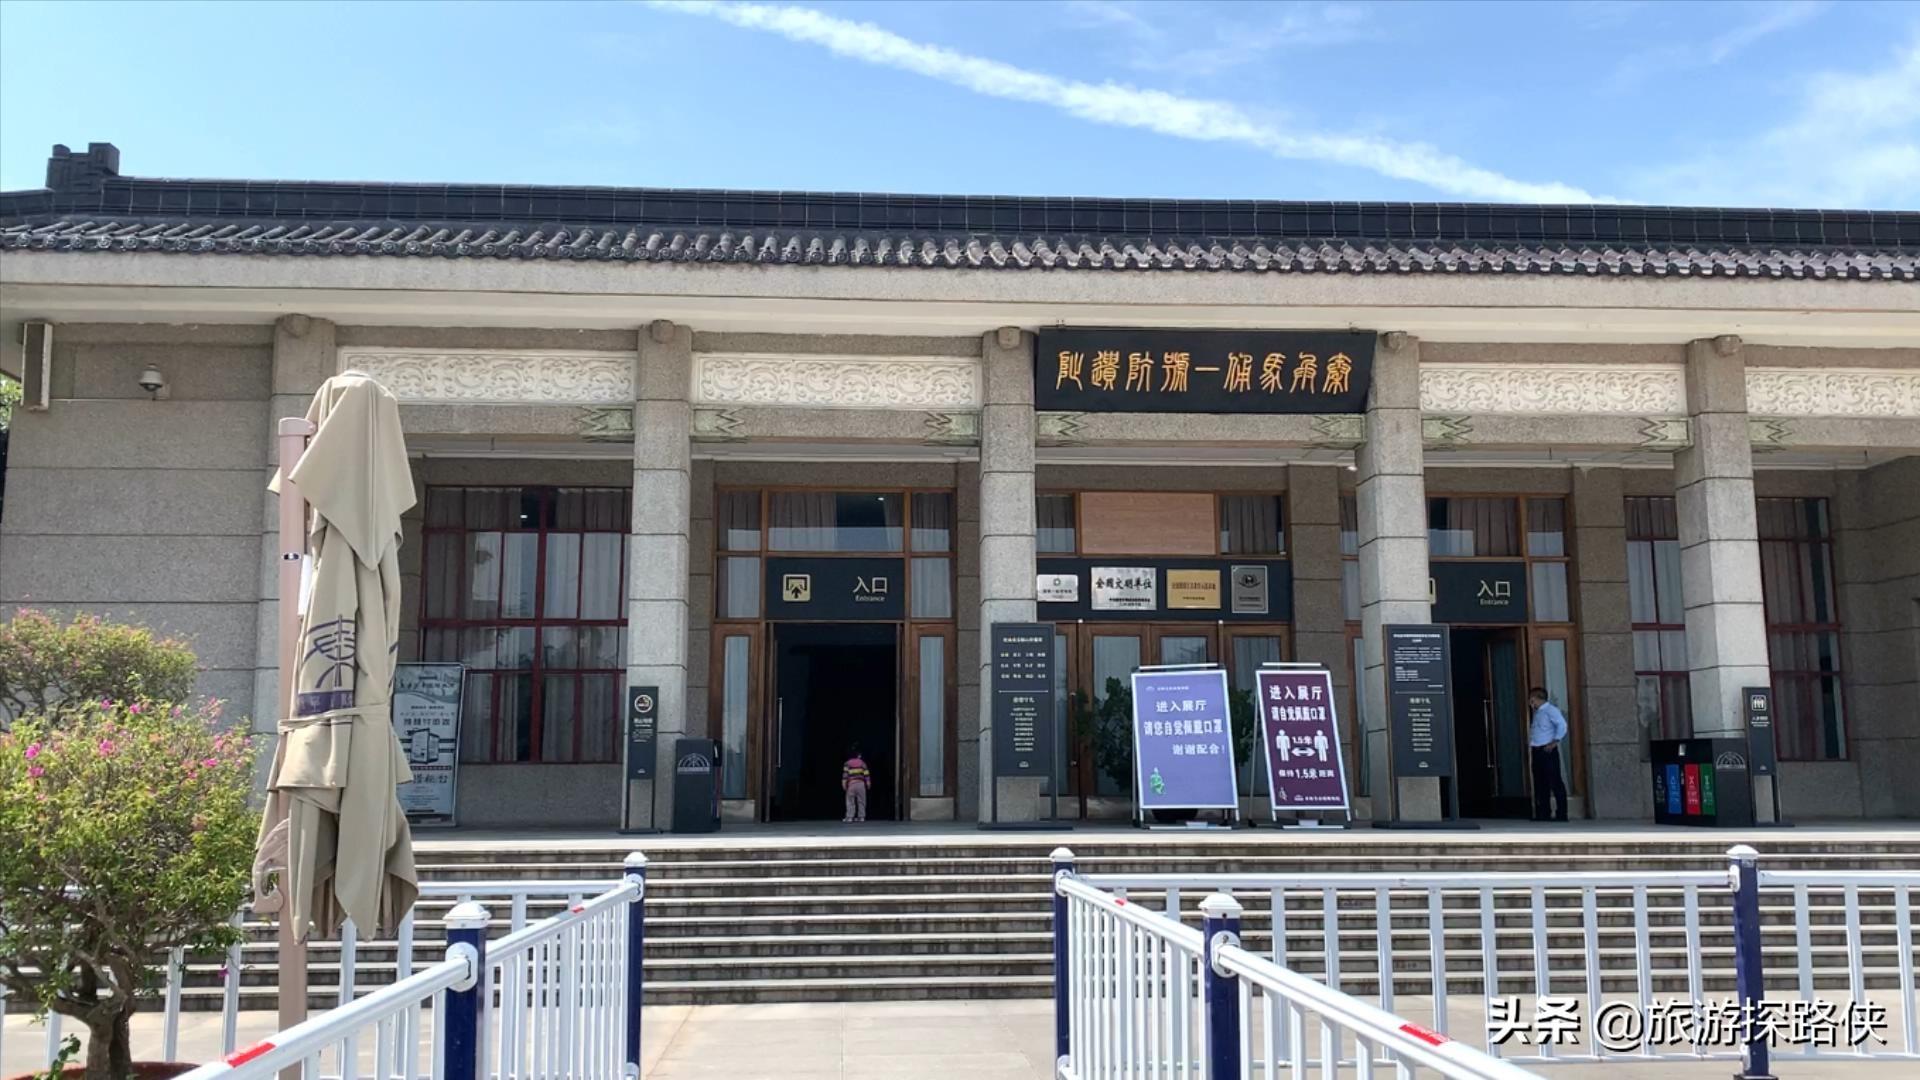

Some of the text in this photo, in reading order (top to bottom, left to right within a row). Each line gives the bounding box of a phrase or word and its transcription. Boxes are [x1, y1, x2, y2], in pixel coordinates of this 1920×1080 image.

[853, 576, 888, 593] 入口
[1477, 580, 1511, 597] 入口
[855, 594, 885, 602] Entrance
[1269, 685, 1323, 700] 进入展厅
[1156, 700, 1207, 712] 进入展厅
[1271, 706, 1326, 721] 请自觉佩戴口罩
[1144, 719, 1223, 736] 请您自觉佩戴口罩
[1292, 736, 1312, 745] 1.5米
